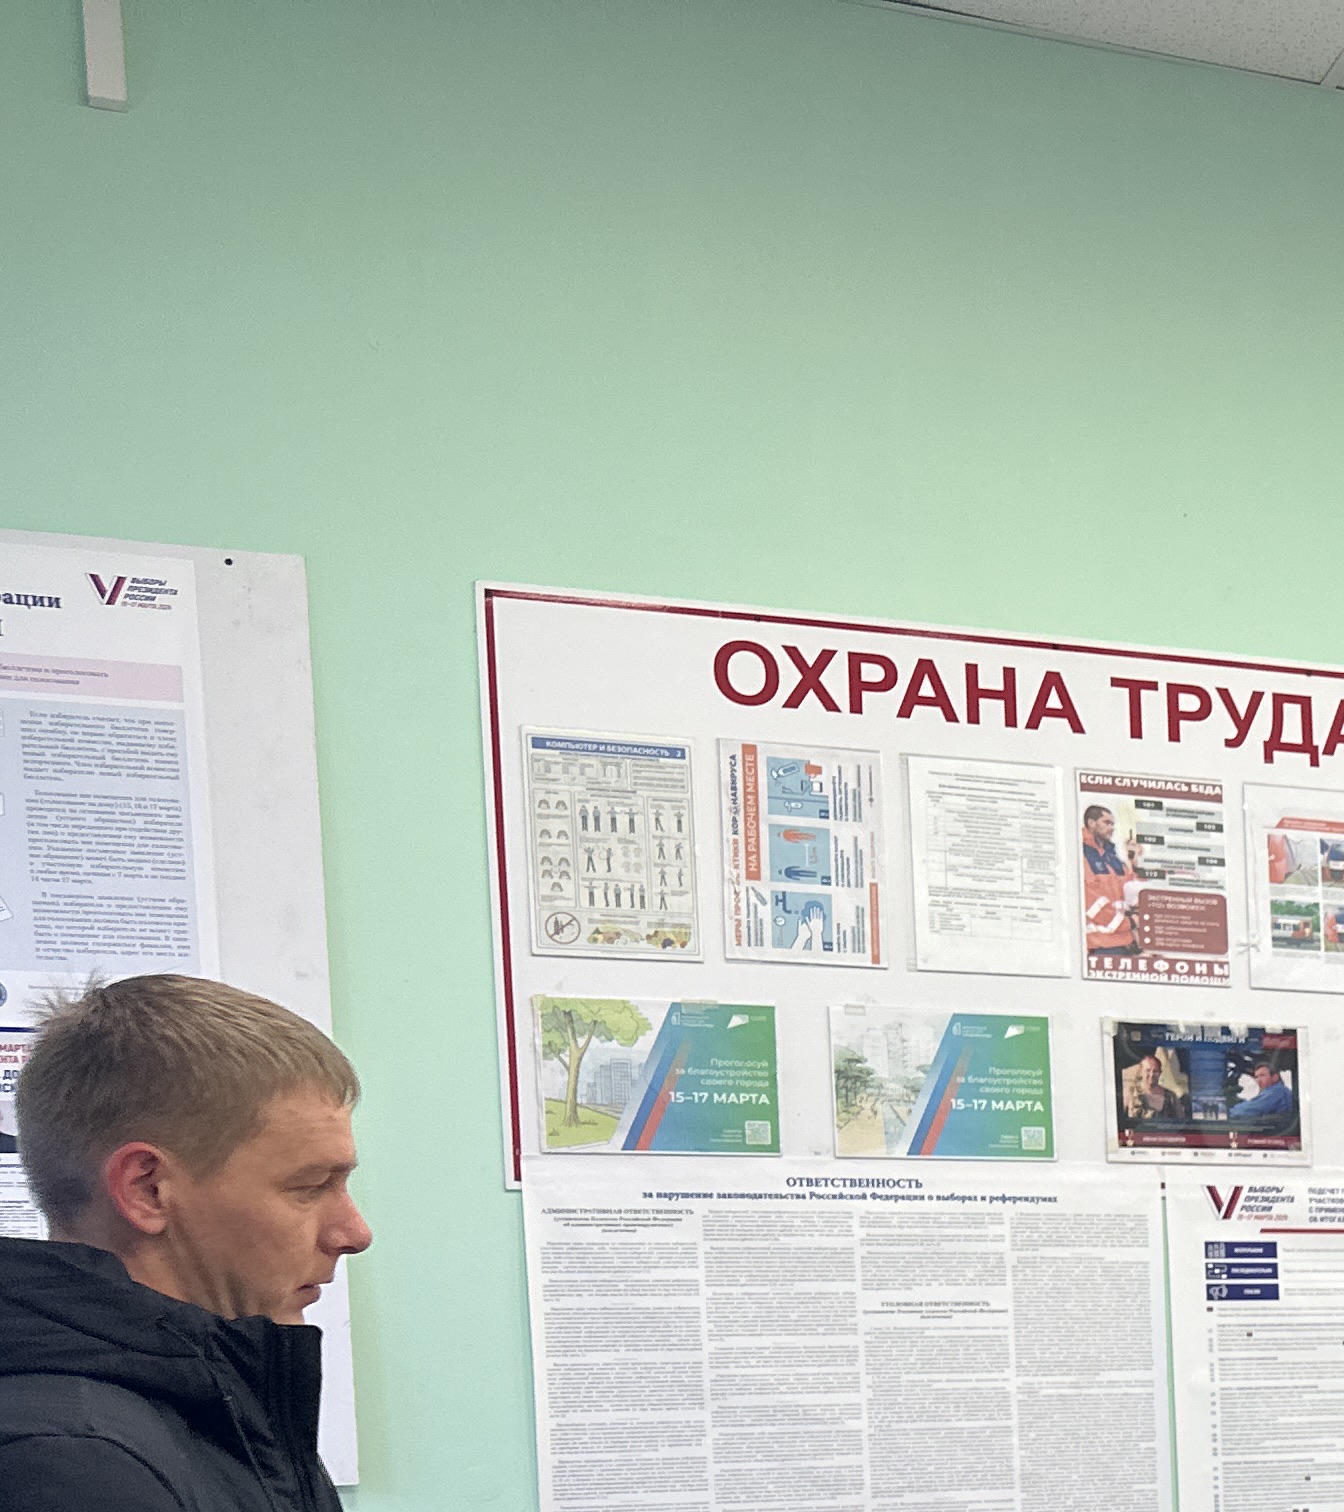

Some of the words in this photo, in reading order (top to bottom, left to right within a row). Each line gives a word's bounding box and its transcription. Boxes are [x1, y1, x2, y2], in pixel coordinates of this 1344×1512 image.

[713, 640, 1086, 735] ОХРАНА
[1081, 775, 1112, 785] ЕСЛИ
[1114, 778, 1189, 792] СЛУЧИЛАСЬ
[1191, 784, 1222, 796] БЕДА
[1088, 956, 1229, 976] ТЕЛЕФОНЫ
[710, 1058, 768, 1069] Проголосуй
[688, 1067, 769, 1077] благоустройство
[713, 1092, 770, 1105] МАРТА
[991, 1100, 1045, 1112] МАРТА
[786, 1177, 923, 1189] ОТВЕТСТВЕННОСТЬ
[1248, 1186, 1284, 1194] ВЫБОРЫ
[642, 1191, 653, 1199] за
[656, 1191, 714, 1201] нарушение
[716, 1191, 806, 1201] законодательства
[809, 1191, 867, 1201] Российской
[870, 1191, 925, 1202] Федерации
[936, 1193, 978, 1202] выборах
[989, 1193, 1058, 1204] референдумах
[1244, 1195, 1295, 1203] ПРЕЗИДЕНТА
[1240, 1205, 1273, 1213] РОССИИ
